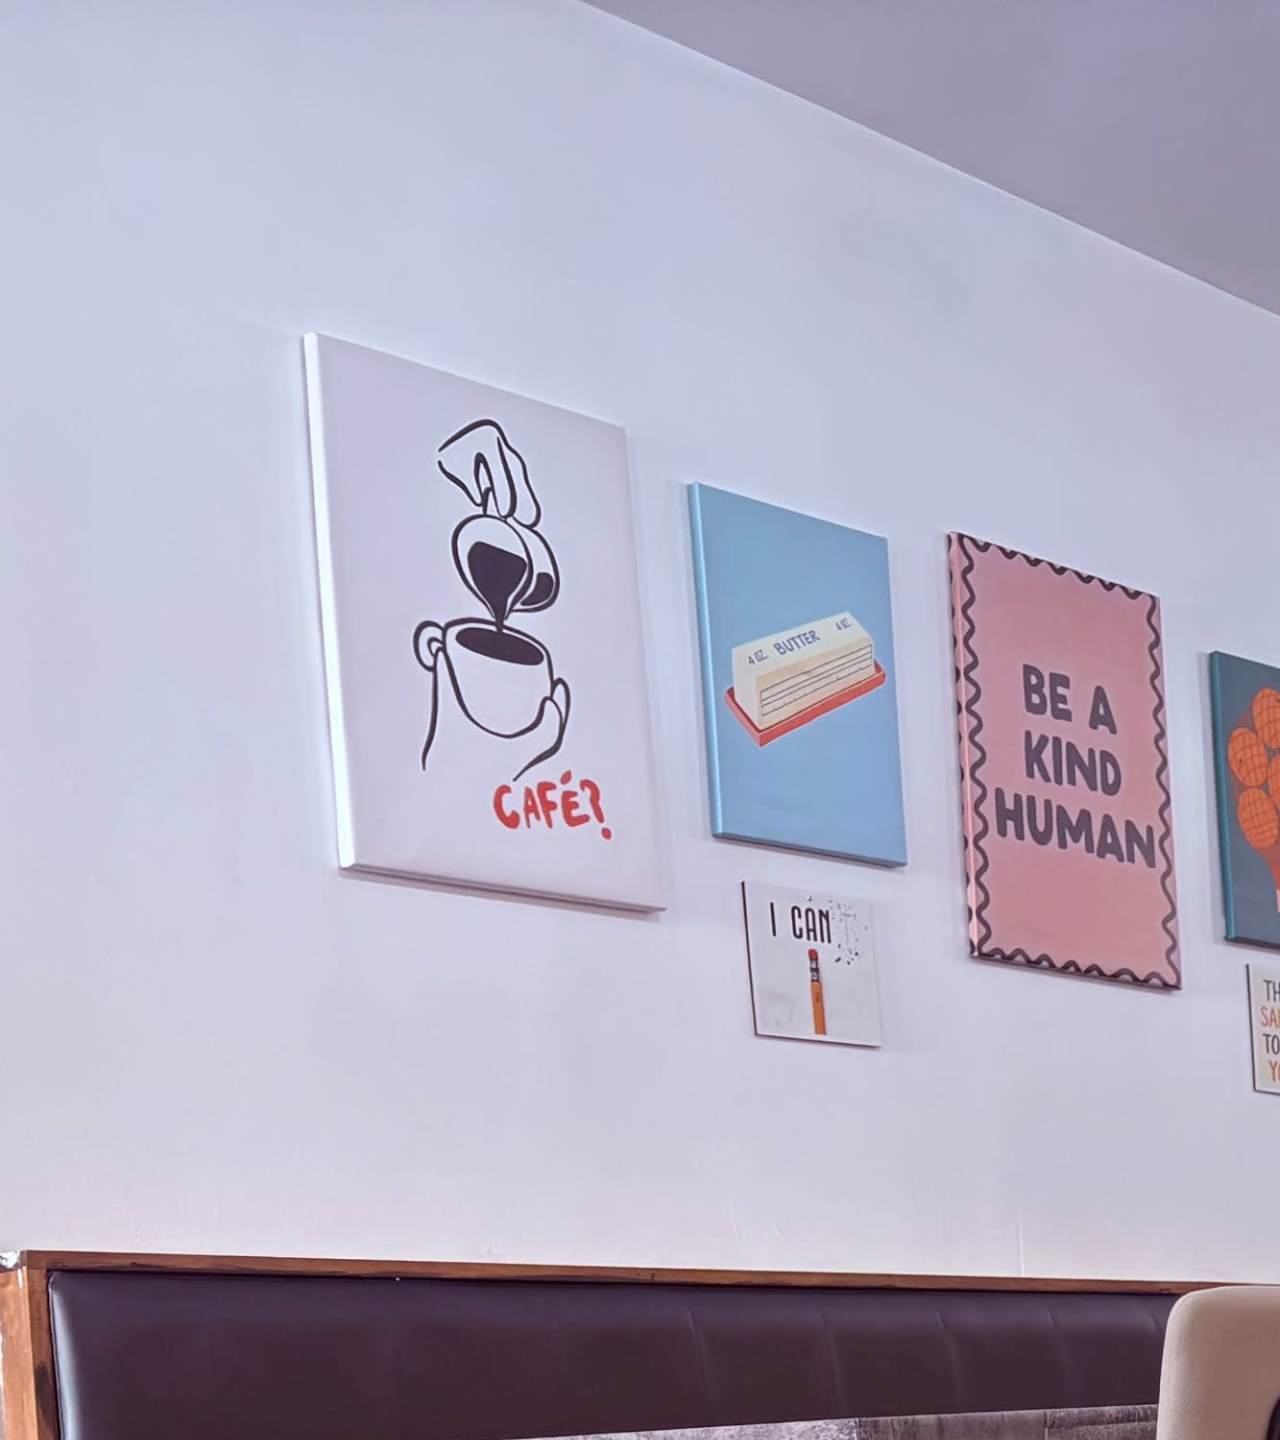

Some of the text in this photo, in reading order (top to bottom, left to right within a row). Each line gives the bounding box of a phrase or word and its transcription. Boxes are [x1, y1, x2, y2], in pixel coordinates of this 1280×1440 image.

[773, 630, 821, 656] BUTTER
[1022, 663, 1118, 735] BE A
[1024, 730, 1122, 796] KIND
[493, 769, 613, 841] CAFÉ?
[994, 787, 1157, 869] HUMAN
[769, 901, 777, 937] I
[1262, 1033, 1280, 1055] TO
